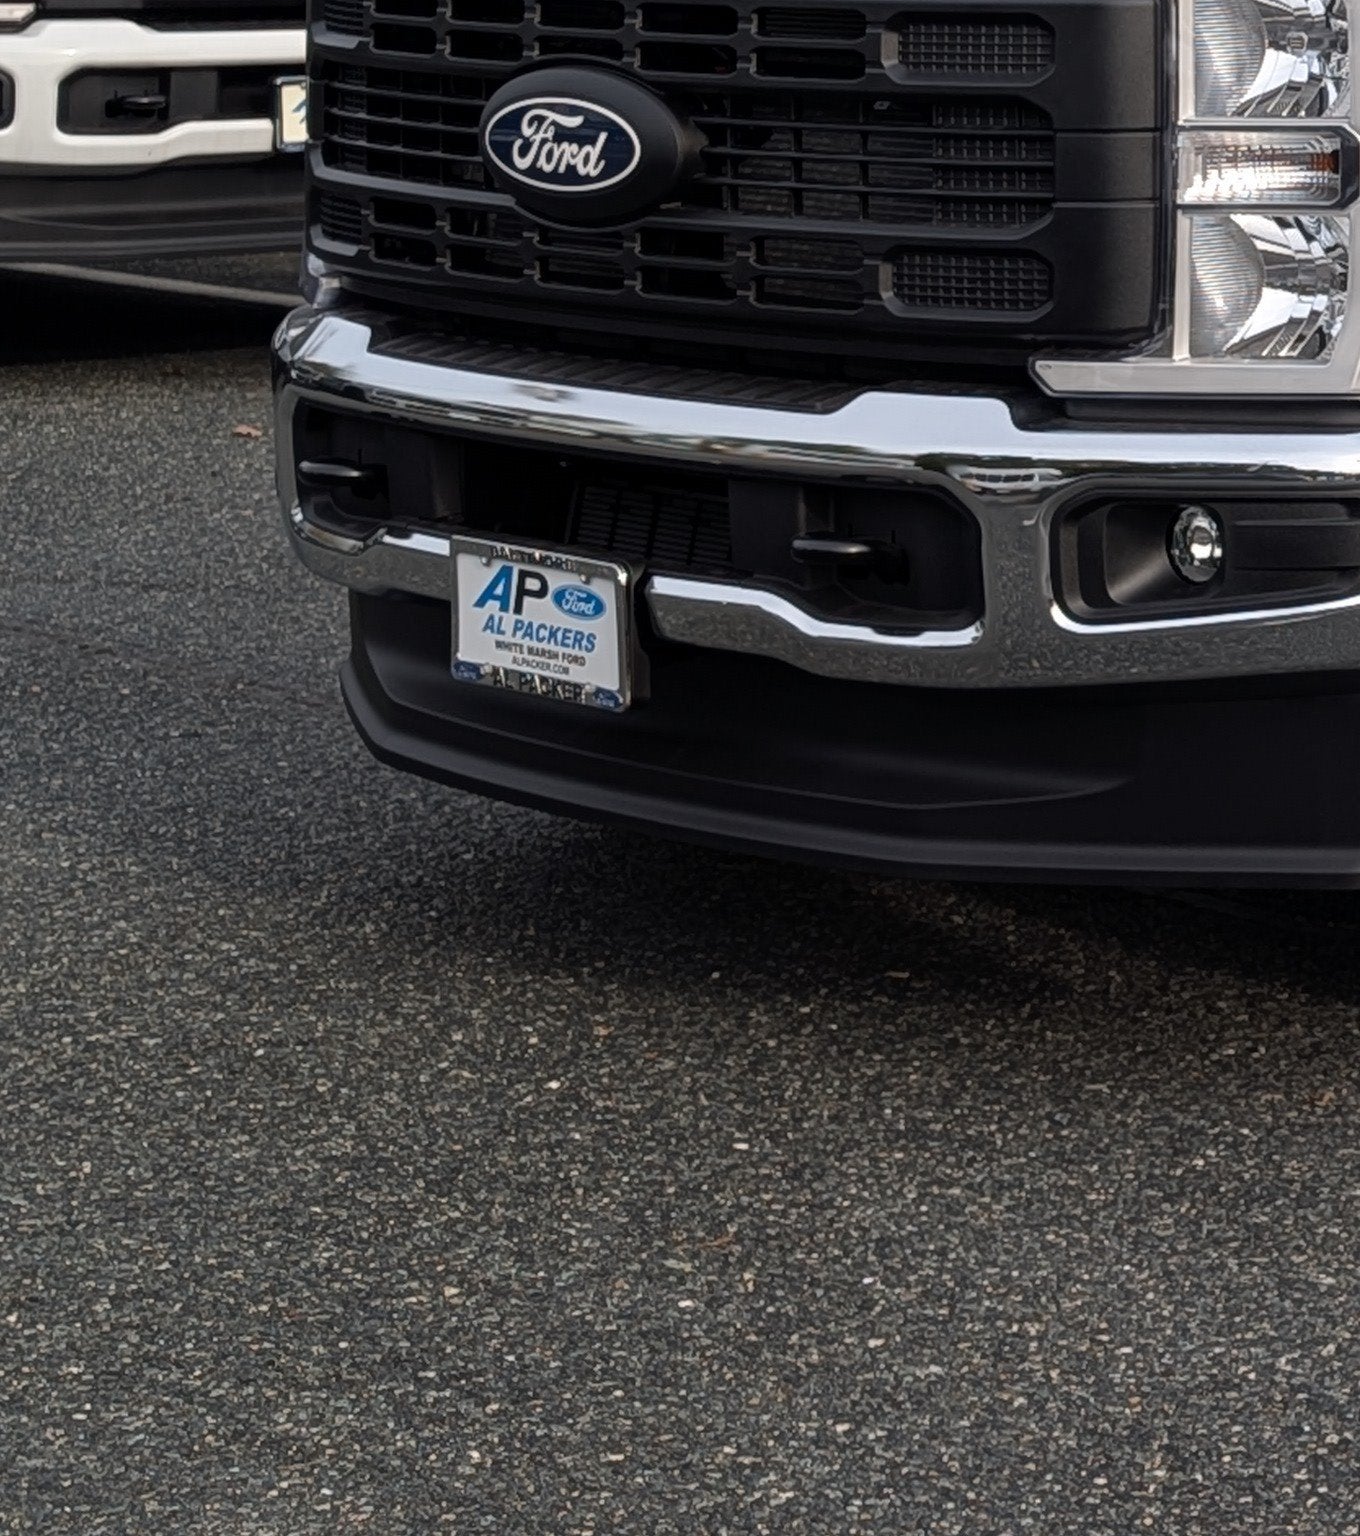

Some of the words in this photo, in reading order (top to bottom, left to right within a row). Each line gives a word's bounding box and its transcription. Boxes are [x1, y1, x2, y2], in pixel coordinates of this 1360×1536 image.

[512, 108, 609, 178] Ford
[472, 564, 549, 616] AP
[561, 588, 596, 616] Ford
[482, 614, 506, 635] AL
[511, 619, 597, 654] PACKERS
[494, 640, 525, 655] WHITE
[527, 646, 560, 662] MARSH
[561, 652, 586, 668] FORD
[511, 656, 570, 676] ALPACKER.COM
